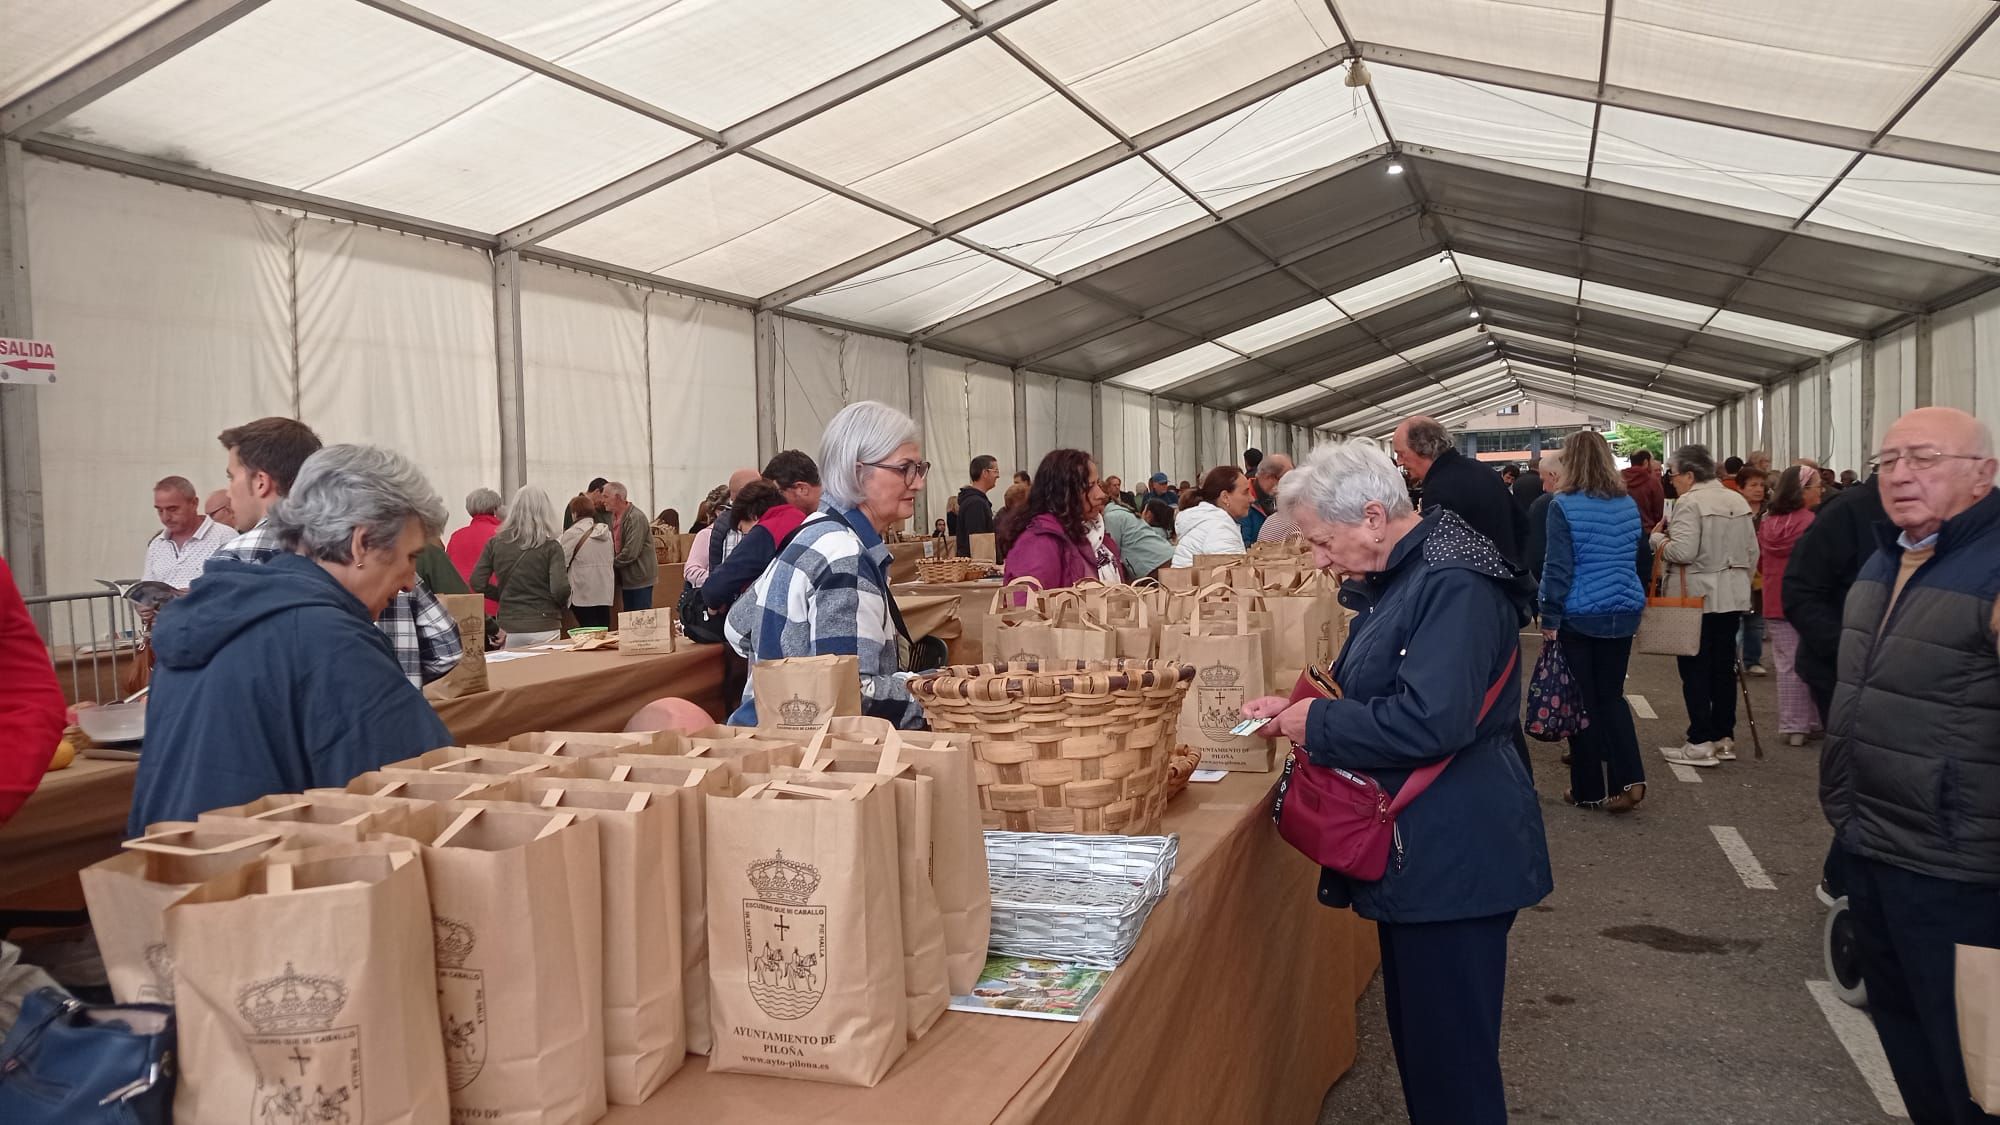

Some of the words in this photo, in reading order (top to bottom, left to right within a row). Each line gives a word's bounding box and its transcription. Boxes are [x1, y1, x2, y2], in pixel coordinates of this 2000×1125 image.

[0, 340, 54, 358] SALIDA
[774, 906, 785, 914] QUE
[733, 1026, 818, 1045] AYUNTAMIENTO
[820, 1034, 837, 1045] DE
[763, 1044, 804, 1057] PILOÑA
[742, 1055, 830, 1070] www.ayto-pilona.es
